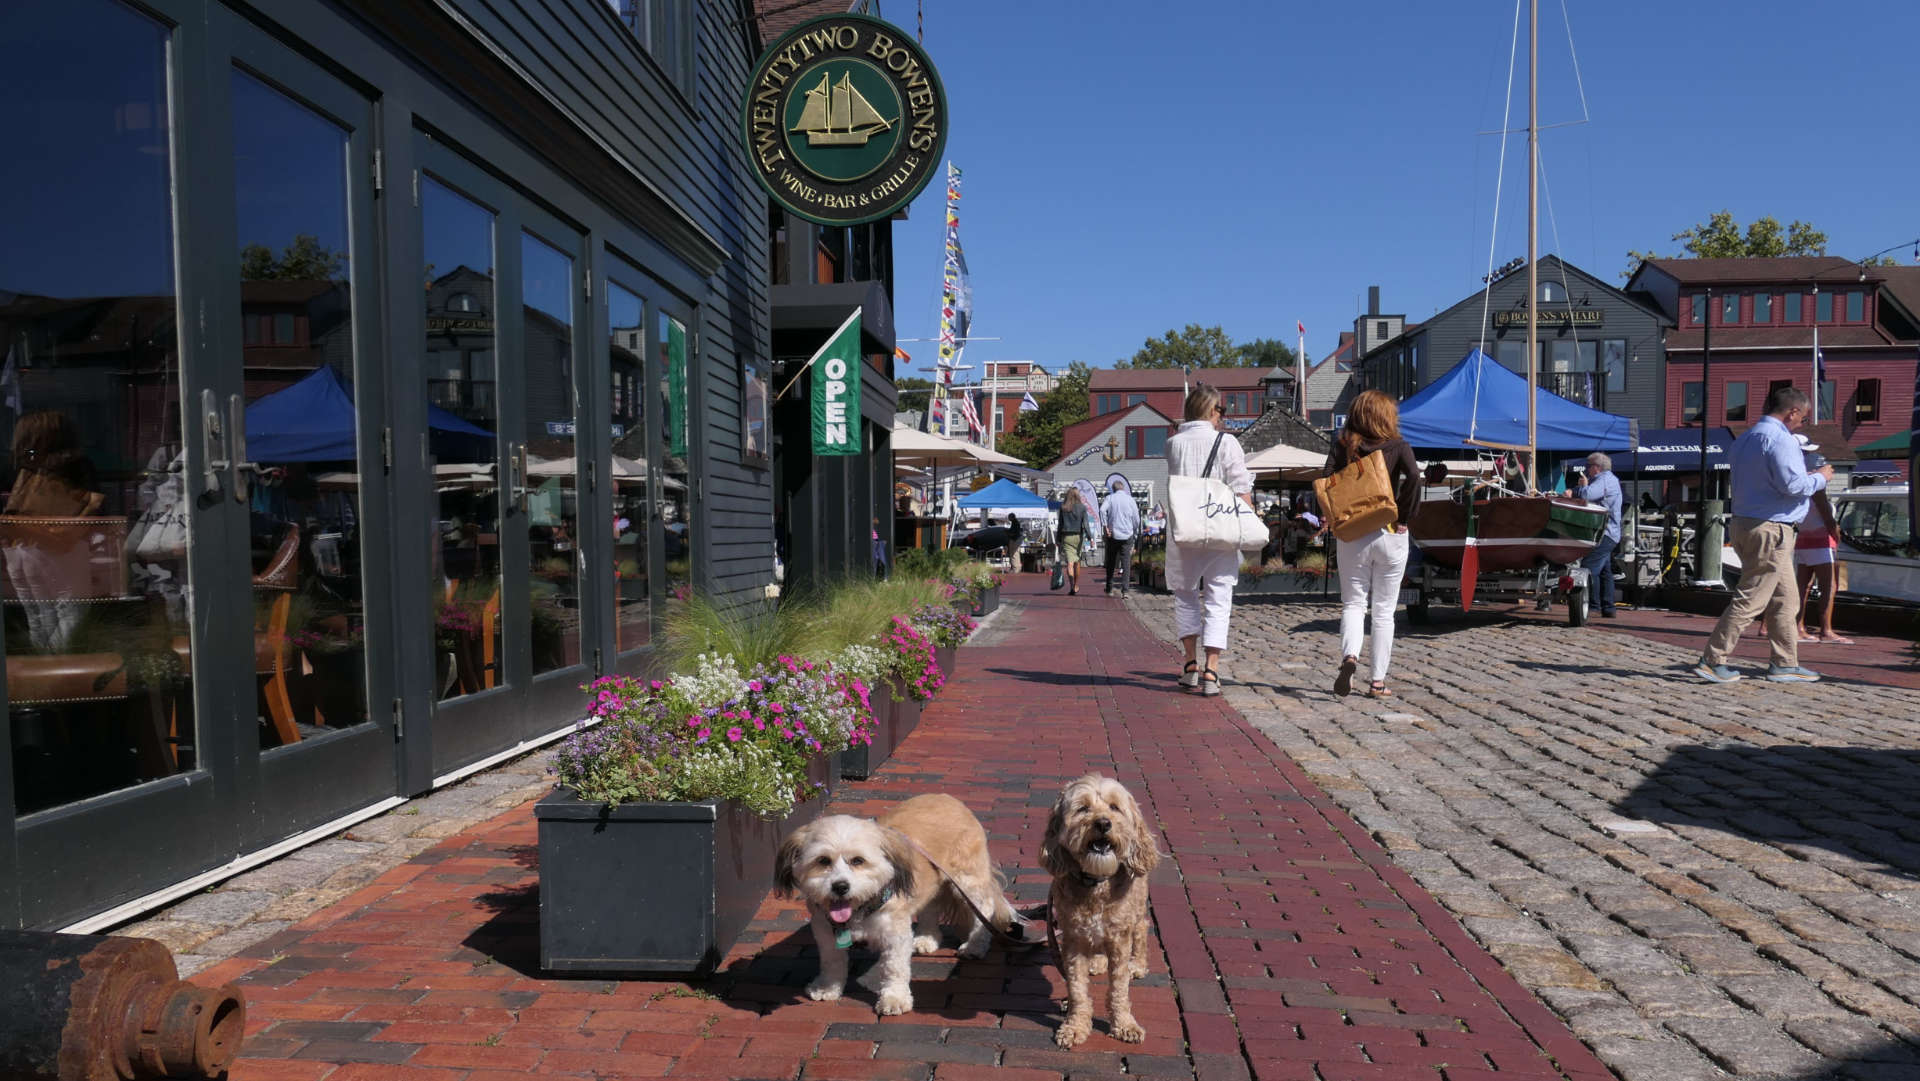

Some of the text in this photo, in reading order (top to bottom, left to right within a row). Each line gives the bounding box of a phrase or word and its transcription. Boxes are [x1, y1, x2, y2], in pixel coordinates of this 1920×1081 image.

[754, 26, 938, 173] TWENTYTWO BOWEN'S
[779, 154, 920, 209] WINE BAR & GRILLE
[825, 358, 847, 444] OPEN
[1198, 492, 1252, 518] tack
